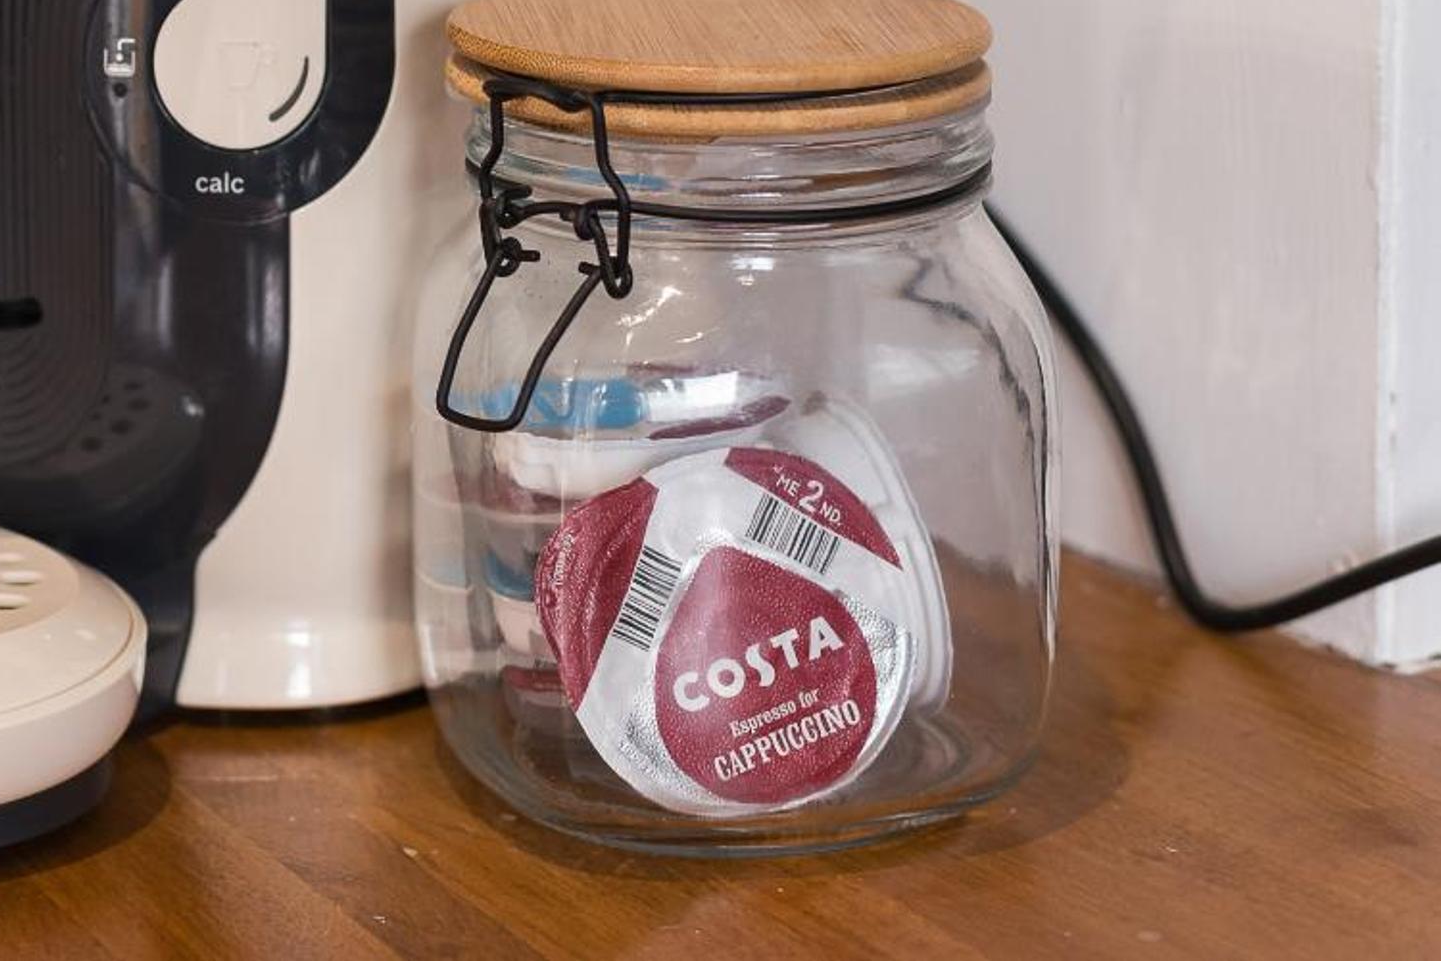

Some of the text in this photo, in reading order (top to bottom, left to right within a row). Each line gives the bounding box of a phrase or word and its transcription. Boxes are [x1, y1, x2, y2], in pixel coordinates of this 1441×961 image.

[195, 172, 245, 194] calc
[775, 473, 800, 497] ME
[672, 615, 844, 713] COSTA
[728, 688, 821, 737] Espresso for
[714, 699, 861, 781] CAPPUCCINO
